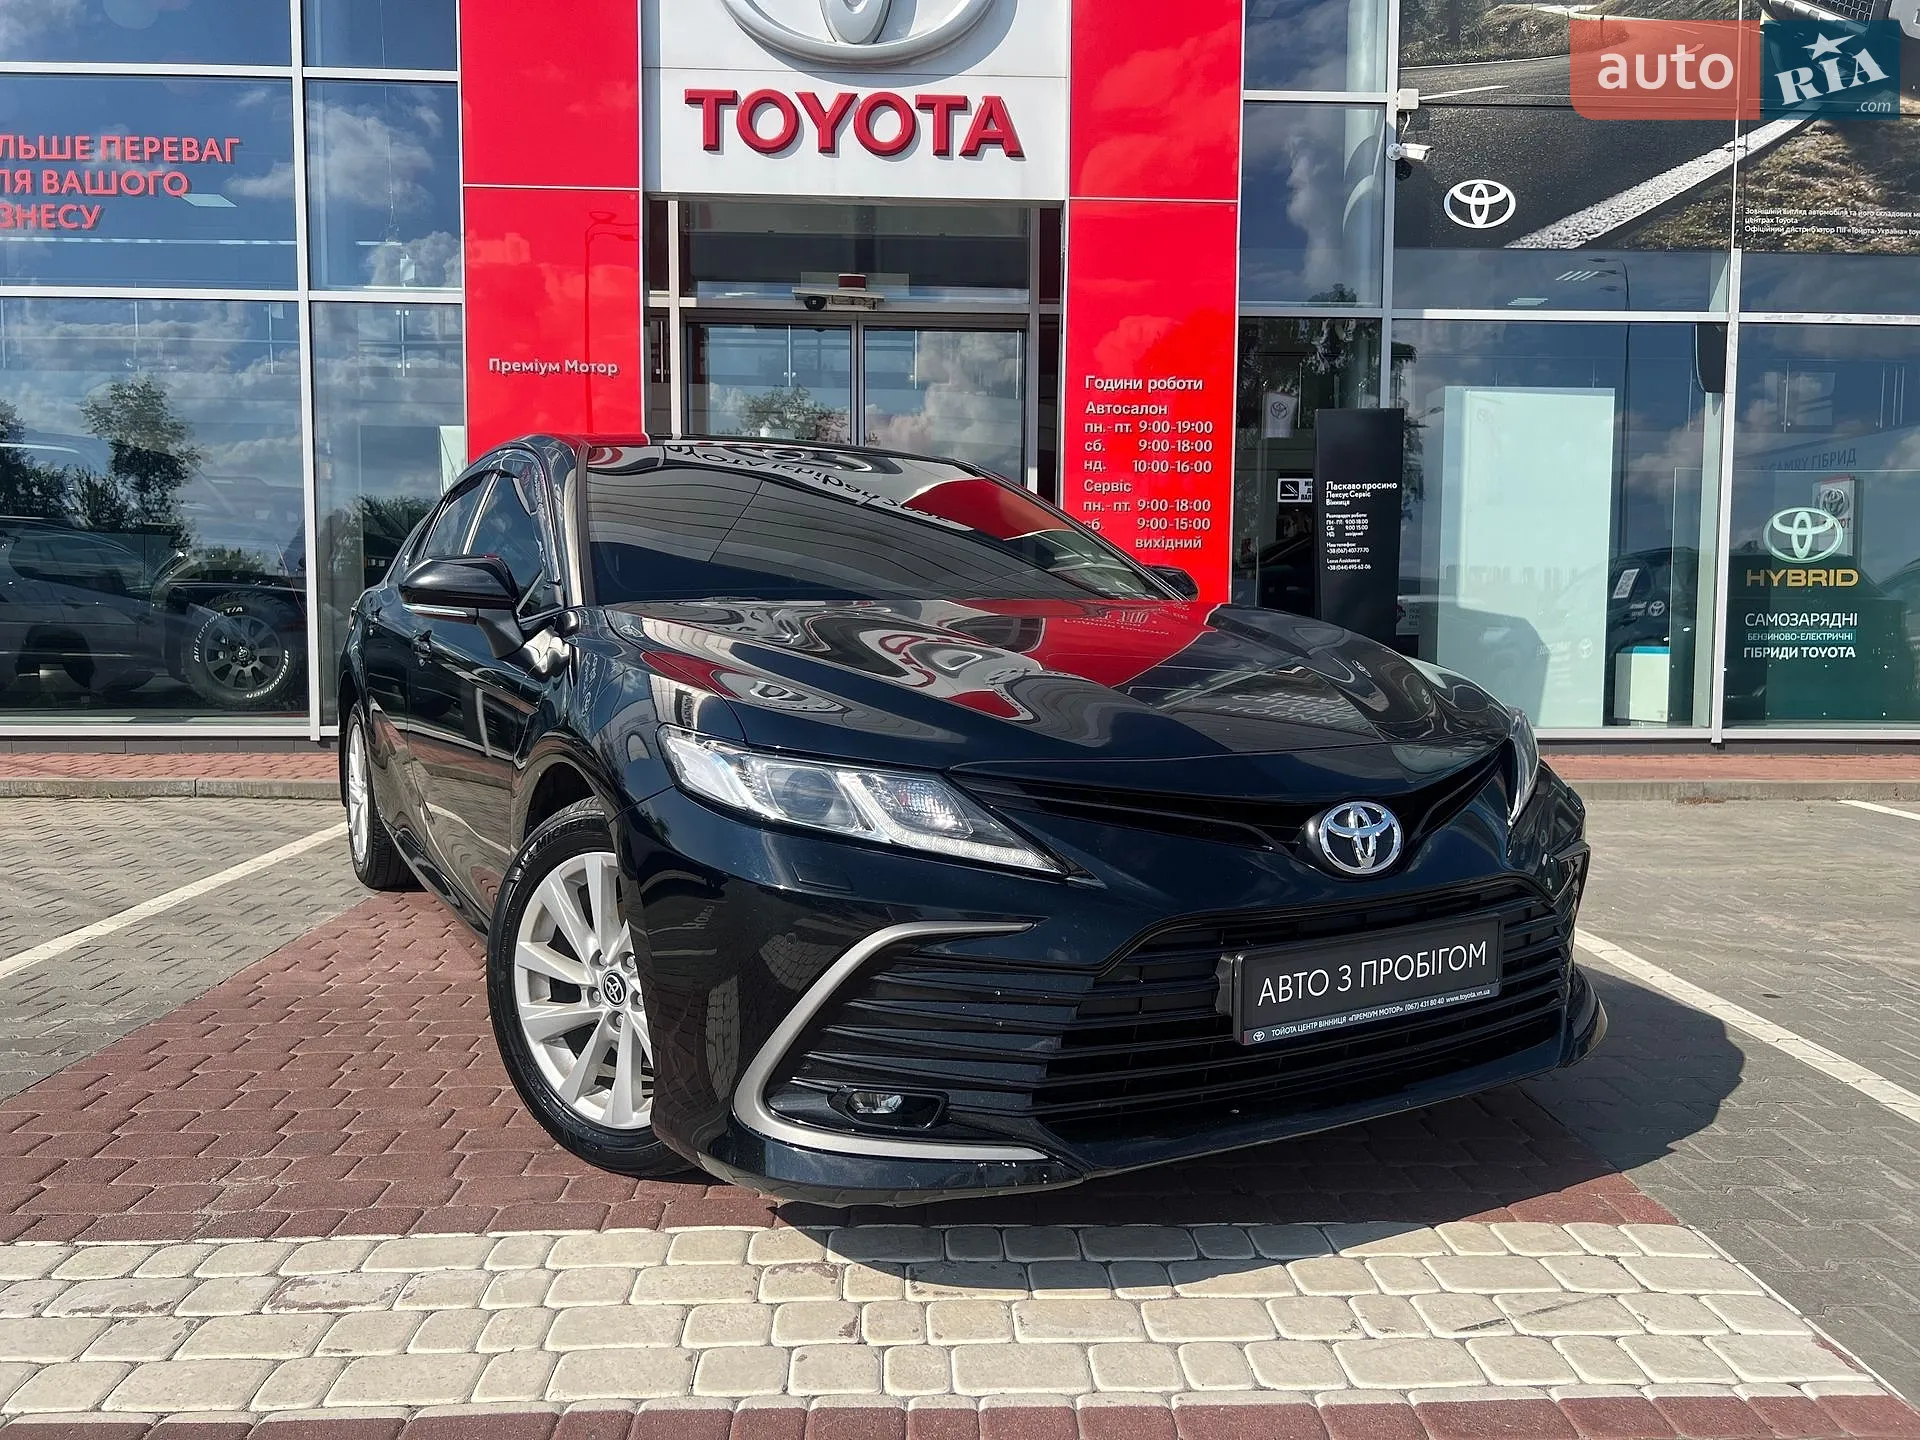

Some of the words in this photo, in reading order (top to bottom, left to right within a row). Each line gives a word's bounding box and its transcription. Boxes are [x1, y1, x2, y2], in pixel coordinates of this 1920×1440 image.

[684, 88, 1025, 158] TOYOTA
[100, 136, 241, 163] ПЕРЕВАГ
[42, 170, 189, 196] ВАШОГО
[488, 358, 561, 376] Преміум
[564, 360, 619, 376] Мотор
[1085, 375, 1143, 392] Години
[1147, 375, 1204, 394] роботи
[1085, 401, 1168, 415] Автосалон
[1138, 420, 1214, 434] 9:00-19:00
[1084, 439, 1106, 452] сб.
[1138, 439, 1213, 453] 9:00-18:00
[1810, 447, 1857, 468] ГІБРИД
[1083, 460, 1107, 472] нд.
[1132, 460, 1213, 473] 10:00-16:00
[1083, 479, 1133, 495] Сервіс
[1326, 481, 1361, 491] Ласкаво
[1362, 482, 1398, 491] просимо
[1349, 490, 1371, 498] Сервіс
[1137, 499, 1212, 512] 9:00-18:00
[1137, 518, 1211, 531] 9:00-15:00
[1135, 536, 1203, 550] вихідний
[1746, 568, 1859, 587] HYBRID
[225, 606, 244, 614] T/A
[1745, 613, 1858, 628] САМОЗАРЯДНІ
[1747, 632, 1853, 641] БЕНЗИНОВО-ЕЛЕКТРИЧНІ
[1743, 647, 1799, 660] ГІБРИДИ
[1800, 646, 1856, 658] TOYOTA
[1257, 968, 1330, 1007] АВТО
[1336, 964, 1352, 992] З
[1359, 940, 1488, 988] ПРОБІГОМ
[1271, 1025, 1297, 1037] ТОЙОТА
[1297, 1021, 1319, 1033] ЦЕНТР
[1318, 1015, 1347, 1029] ВІННИЦЯ
[1348, 1010, 1379, 1023] «ПРЕМІУМ
[1378, 1006, 1403, 1018] МОТОР»
[1404, 1002, 1420, 1012] (067)
[1420, 1000, 1429, 1009] 431
[1429, 998, 1437, 1007] 80
[1437, 997, 1445, 1005] 40
